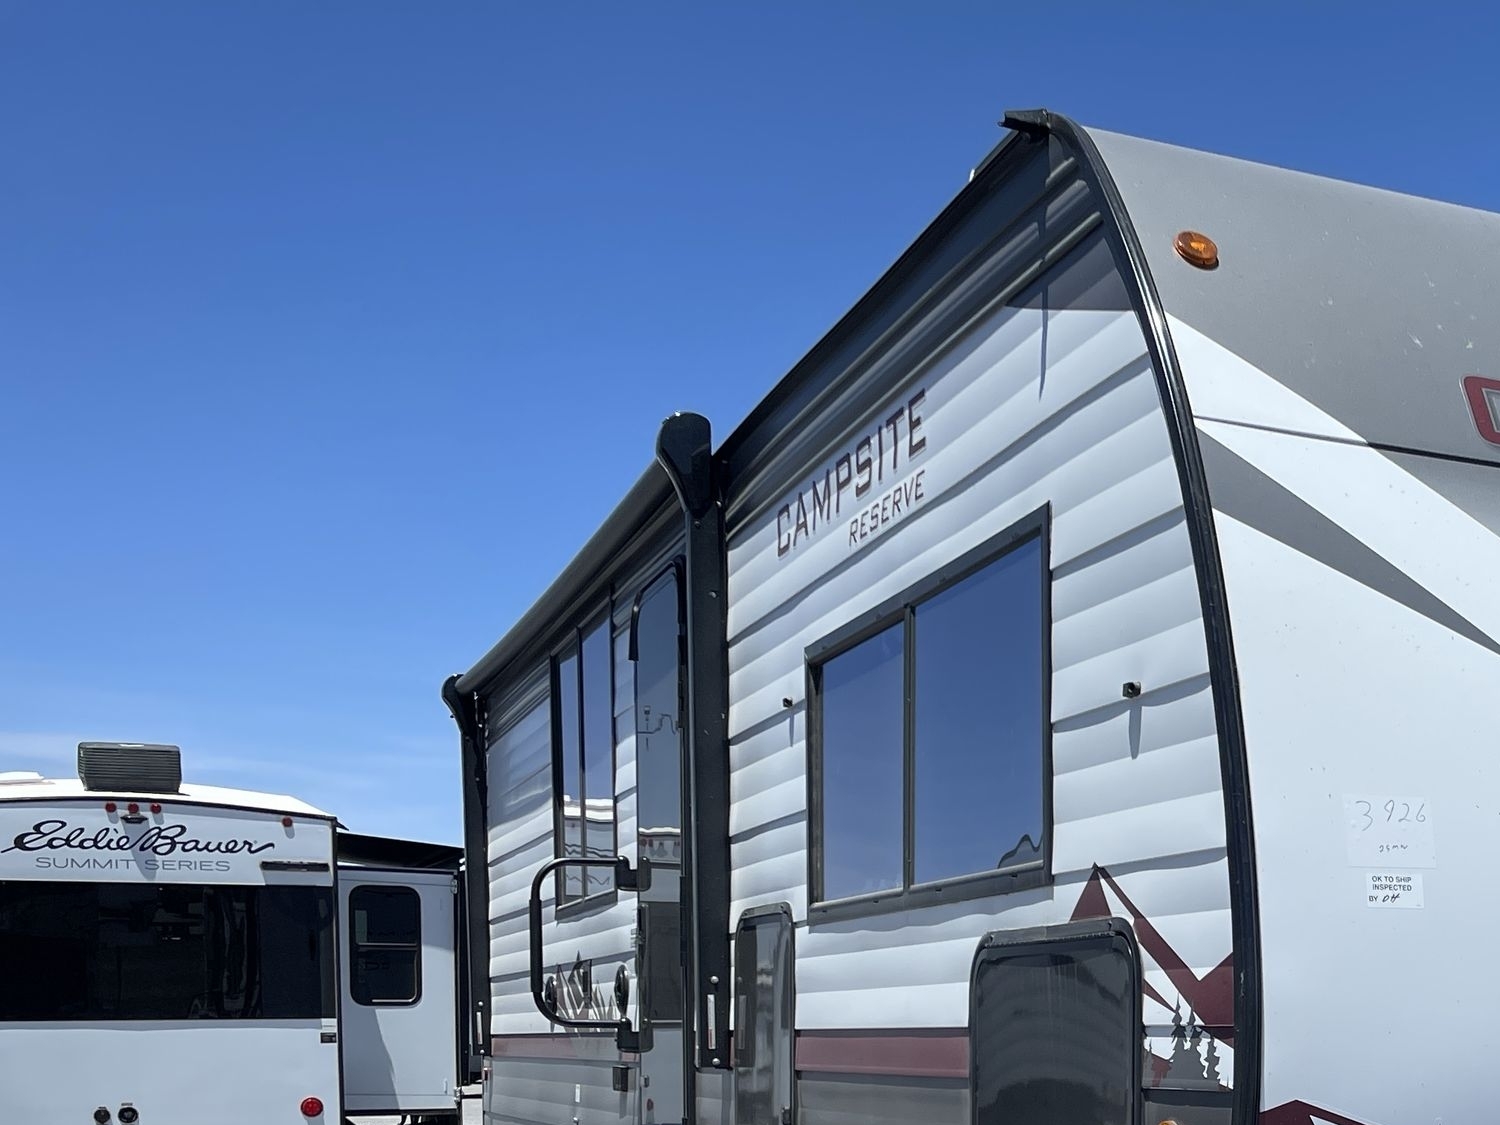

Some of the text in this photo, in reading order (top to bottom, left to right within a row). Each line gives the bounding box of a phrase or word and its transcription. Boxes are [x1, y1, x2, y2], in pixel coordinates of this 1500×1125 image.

[776, 387, 927, 558] CAMPSITE
[848, 469, 926, 547] RESERVE
[1, 819, 274, 856] Eddie Bauer
[35, 856, 231, 872] SUMMIT SERIES
[1371, 875, 1382, 883] OK
